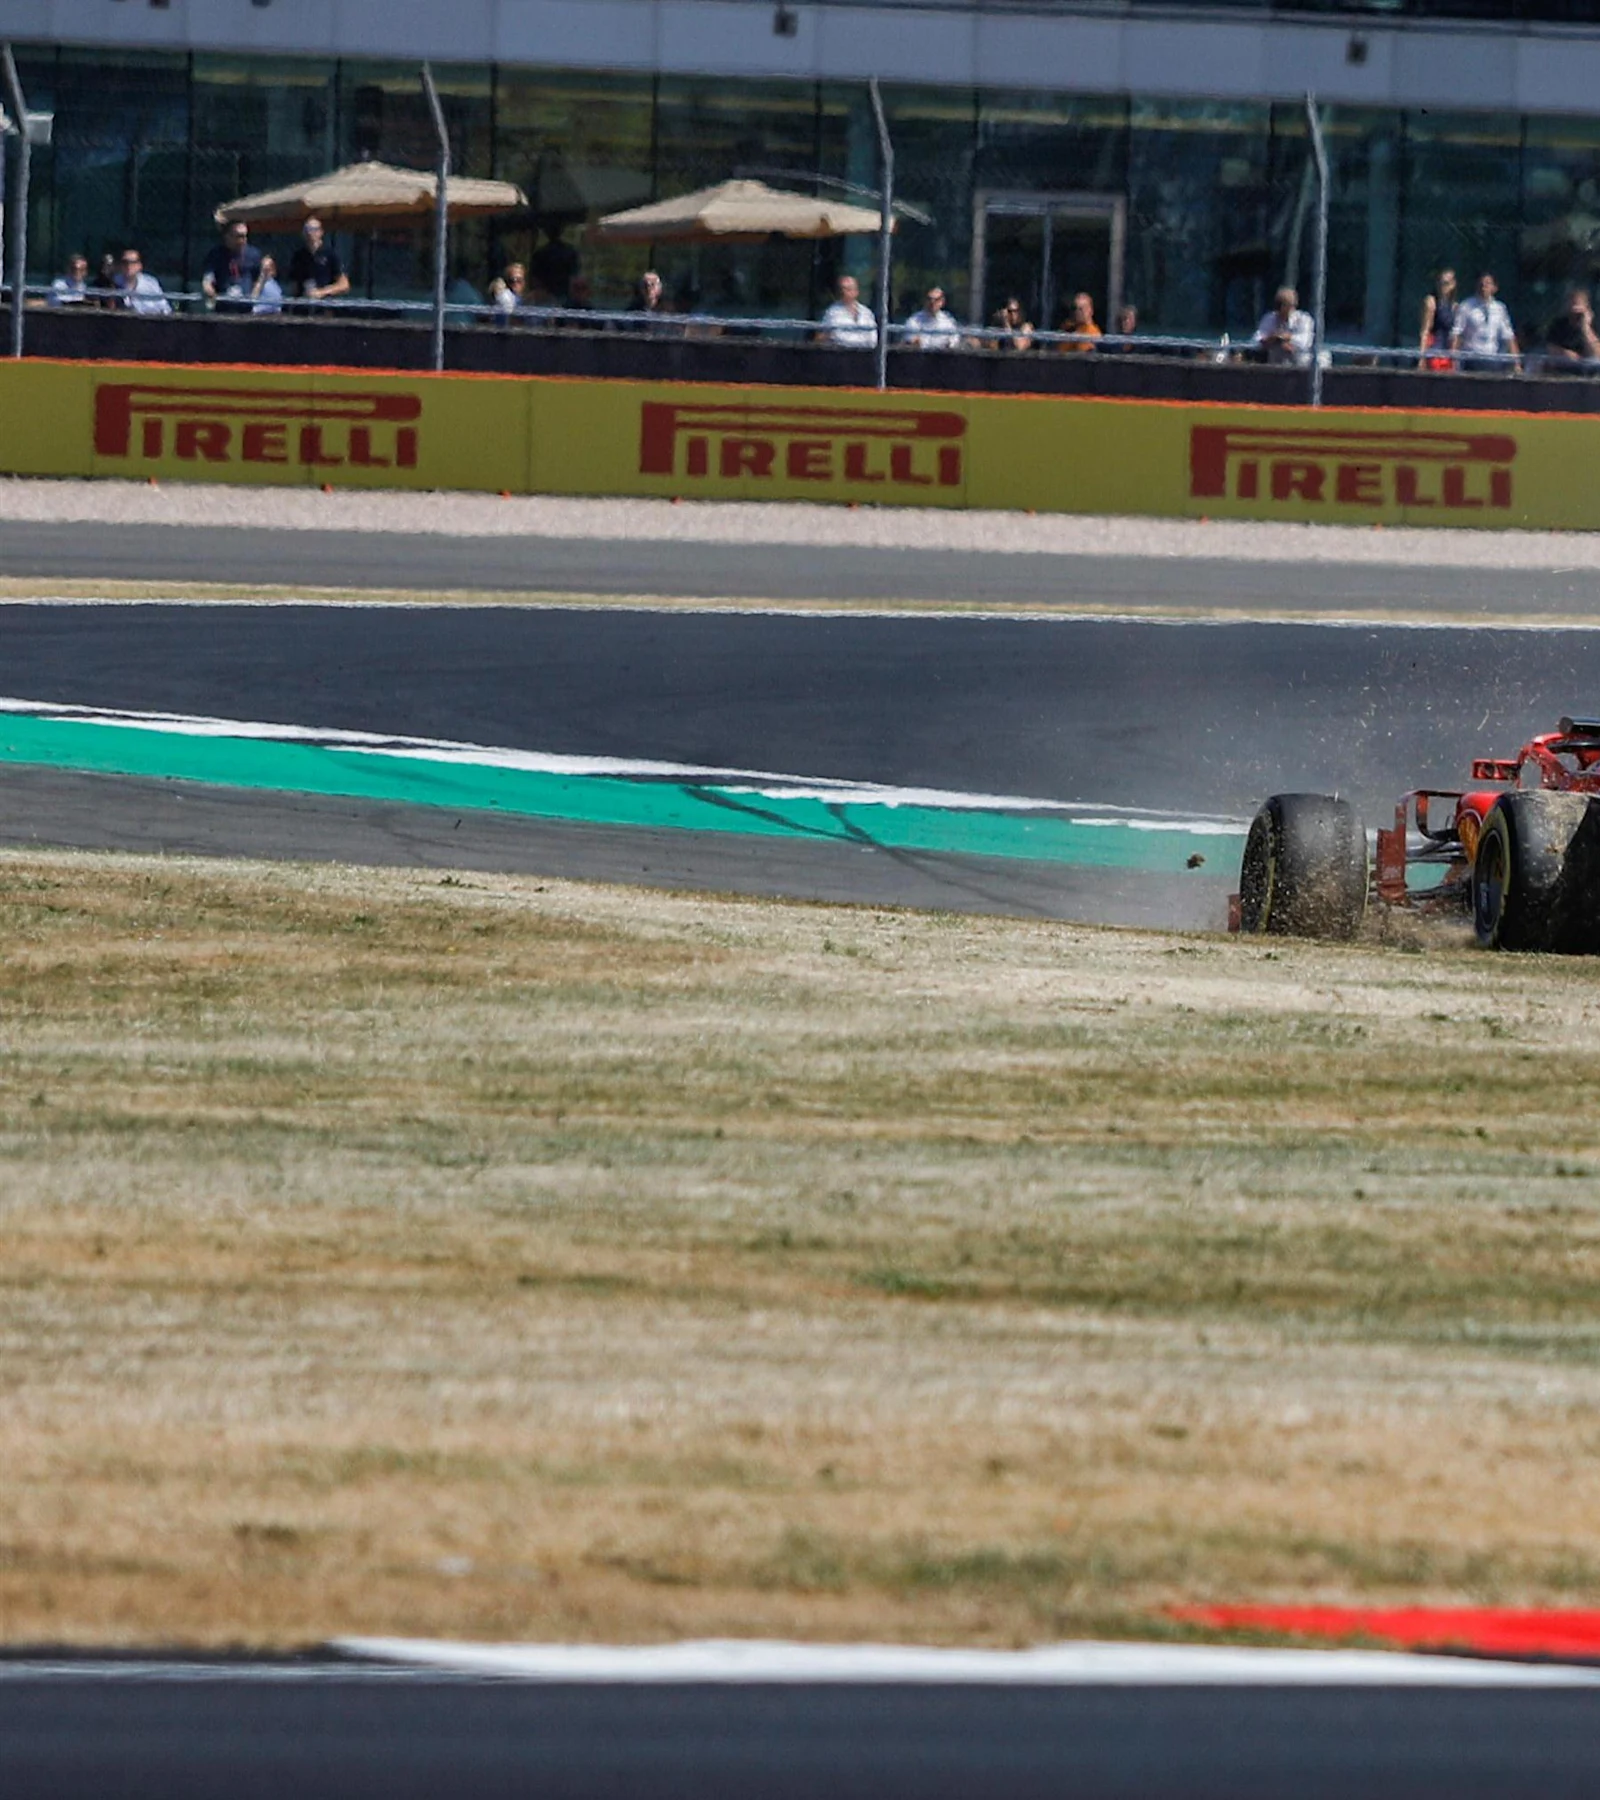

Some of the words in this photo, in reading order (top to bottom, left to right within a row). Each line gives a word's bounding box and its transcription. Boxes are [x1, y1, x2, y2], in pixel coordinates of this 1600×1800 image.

[95, 384, 421, 468] PIRELLI
[641, 404, 966, 487] PIRELLI
[1191, 426, 1518, 507] PIRELLI
